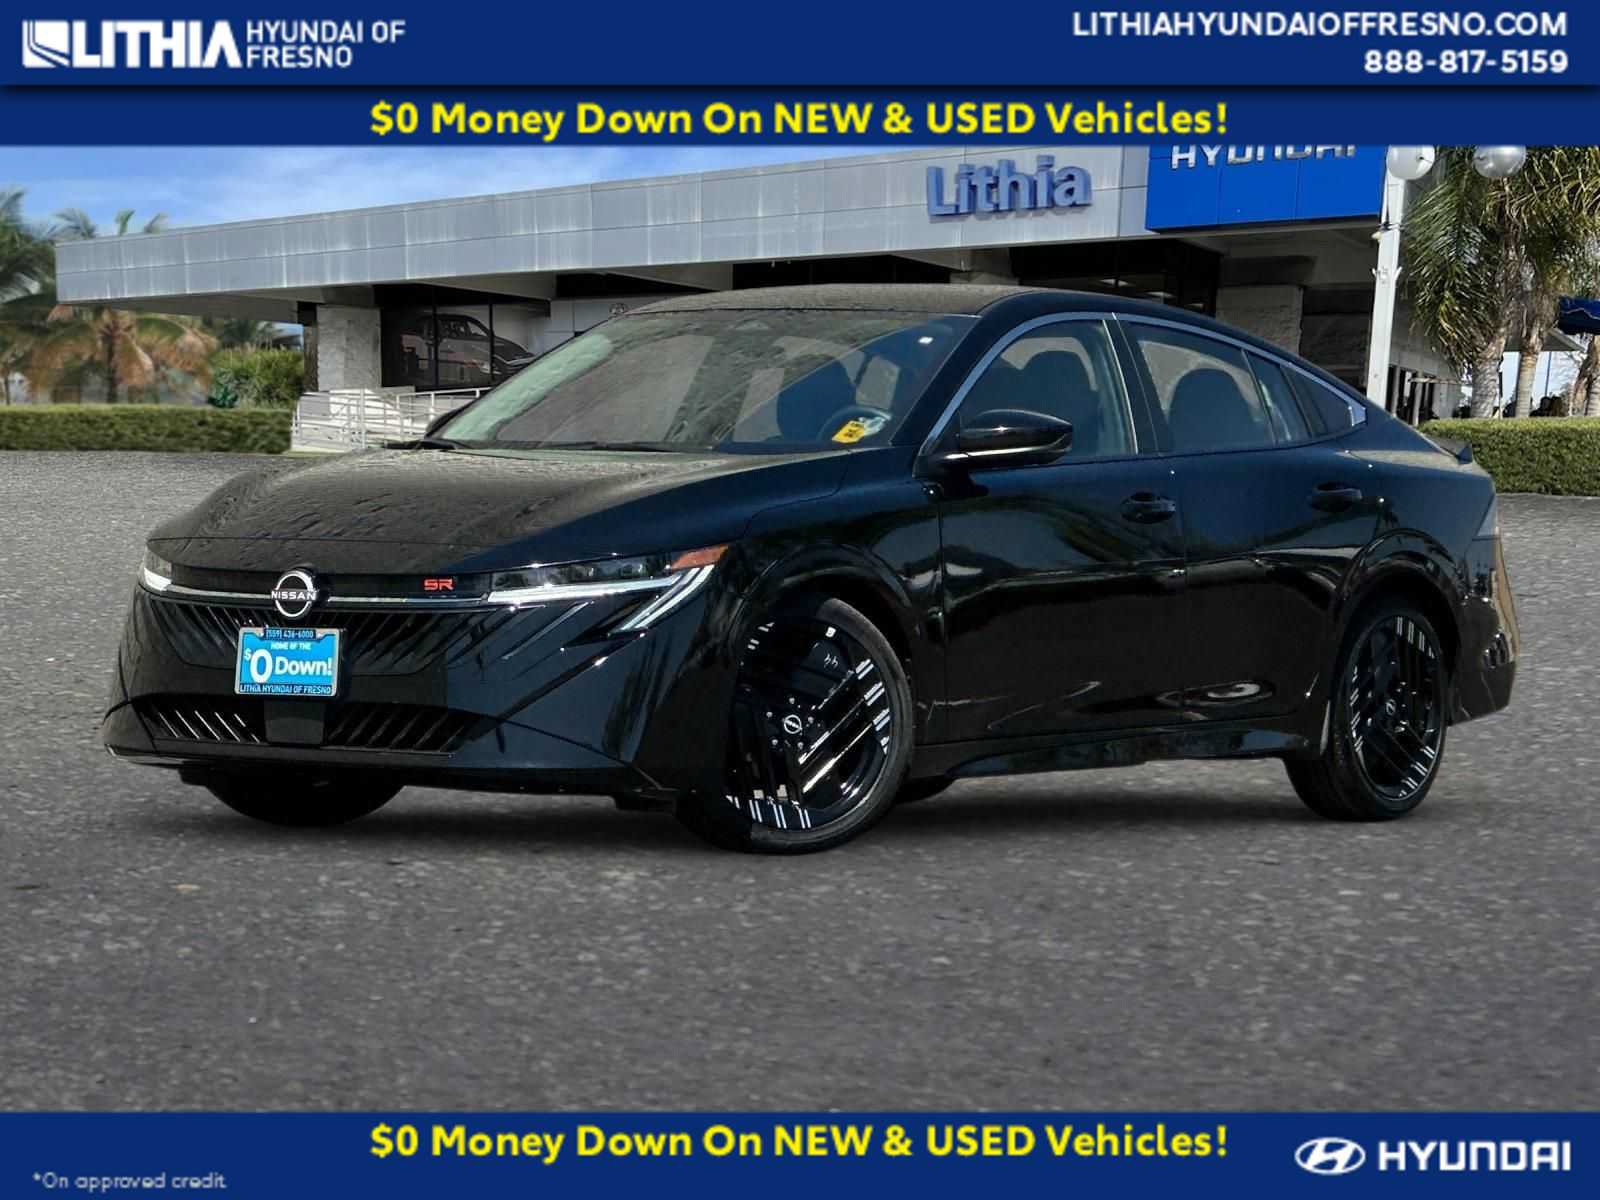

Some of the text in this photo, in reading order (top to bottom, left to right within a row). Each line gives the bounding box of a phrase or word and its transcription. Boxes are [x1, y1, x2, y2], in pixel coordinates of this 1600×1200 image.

[927, 154, 1092, 217] Lithia
[423, 578, 454, 591] SR
[271, 590, 316, 600] NISSAN
[274, 656, 333, 676] Down!
[240, 684, 262, 693] LITHIA
[262, 685, 292, 693] HYUNDAI
[303, 685, 331, 694] FRESNO
